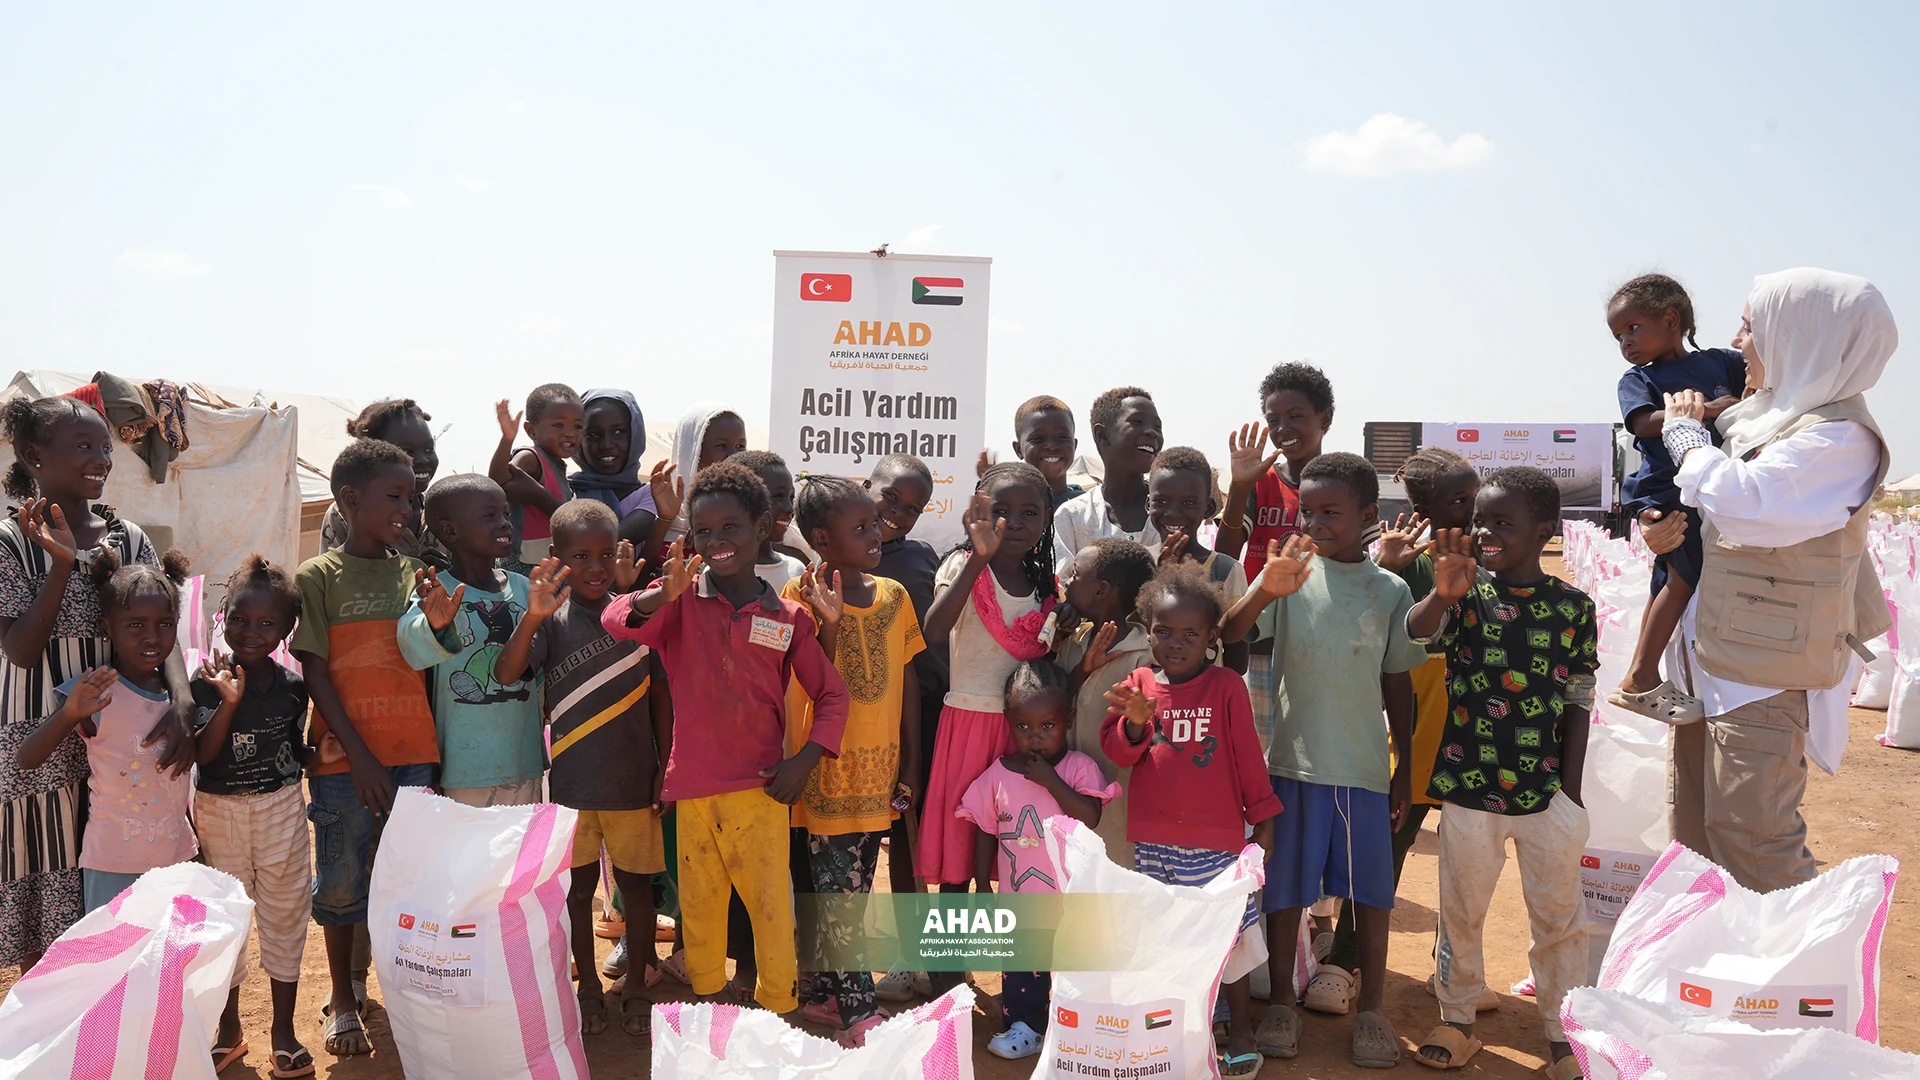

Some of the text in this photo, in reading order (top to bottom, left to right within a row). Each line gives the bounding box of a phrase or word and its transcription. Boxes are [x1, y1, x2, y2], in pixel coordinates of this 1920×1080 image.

[833, 320, 932, 346] AHAD
[830, 350, 929, 361] AFRİKA HAYAT DERNEĞİ
[865, 361, 893, 370] الحياة
[895, 362, 928, 372] جمعية
[800, 388, 957, 420] Acil Yardım
[800, 425, 957, 464] Çalışmaları
[1500, 449, 1532, 465] الإغاثة
[1535, 451, 1575, 466] مشاريع
[1542, 466, 1575, 478] maları
[1163, 708, 1212, 719] DWYANE
[1192, 735, 1218, 768] 3
[1613, 861, 1641, 872] AHAD
[1596, 892, 1622, 904] Yardım
[421, 920, 439, 933] AHAD
[426, 965, 471, 980] Çalışmaları
[1734, 996, 1779, 1009] AHAD
[1096, 1014, 1129, 1029] AHAD
[1057, 1040, 1168, 1064] مشاريع الإغاثة العاجلة
[1057, 1058, 1171, 1080] Acil Yardım Çalışmaları
